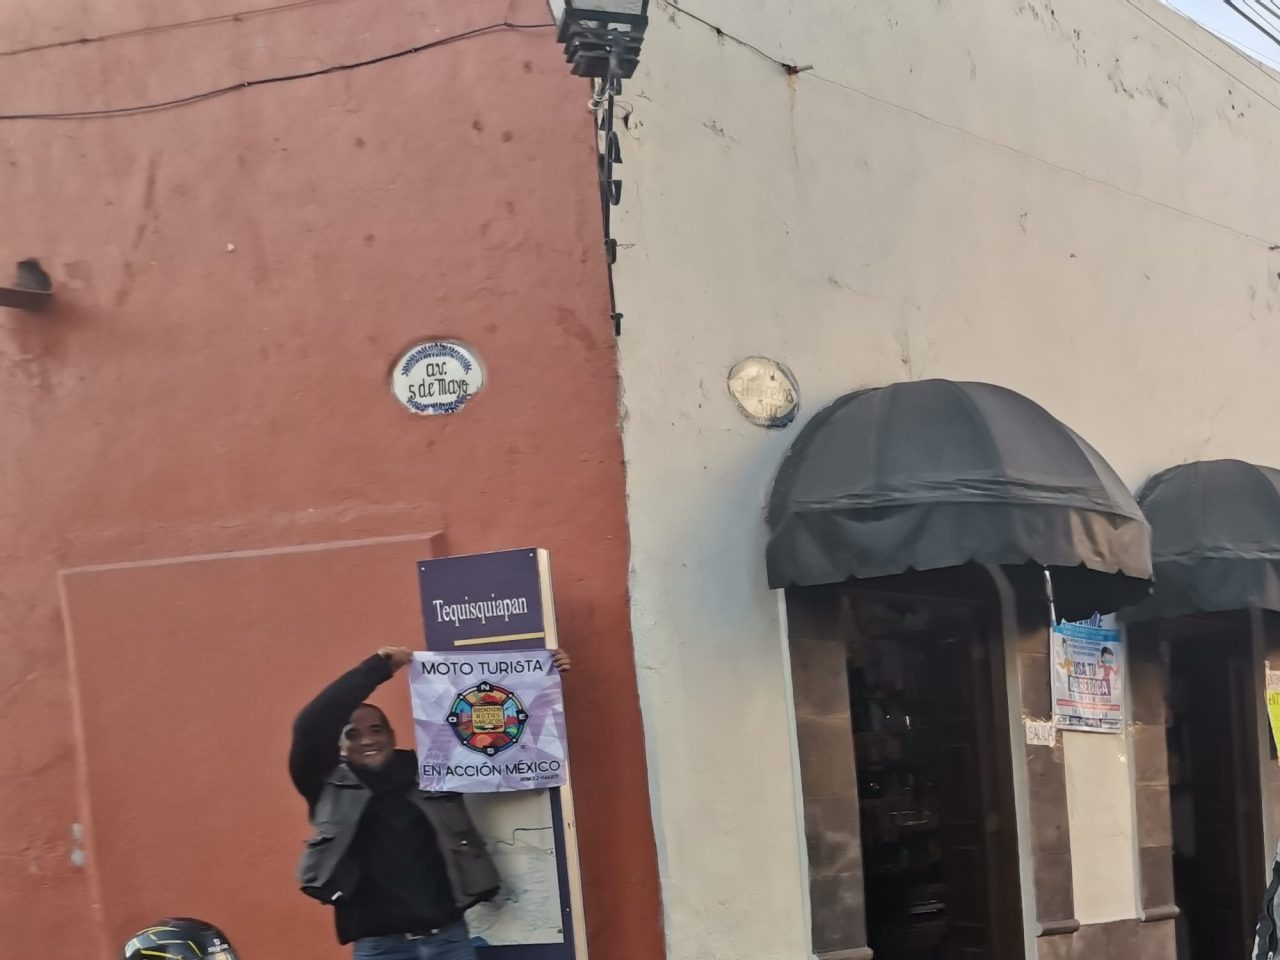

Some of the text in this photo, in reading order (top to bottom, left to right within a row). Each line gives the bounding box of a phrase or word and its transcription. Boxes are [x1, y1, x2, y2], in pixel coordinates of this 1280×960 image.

[418, 378, 436, 398] de
[434, 378, 470, 398] Mayo
[433, 593, 528, 626] Tequisquiapan
[421, 659, 543, 676] MOTO TURISTA
[1073, 661, 1097, 677] USA TU
[423, 760, 561, 777] EN ACCIÓN MÉXICO
